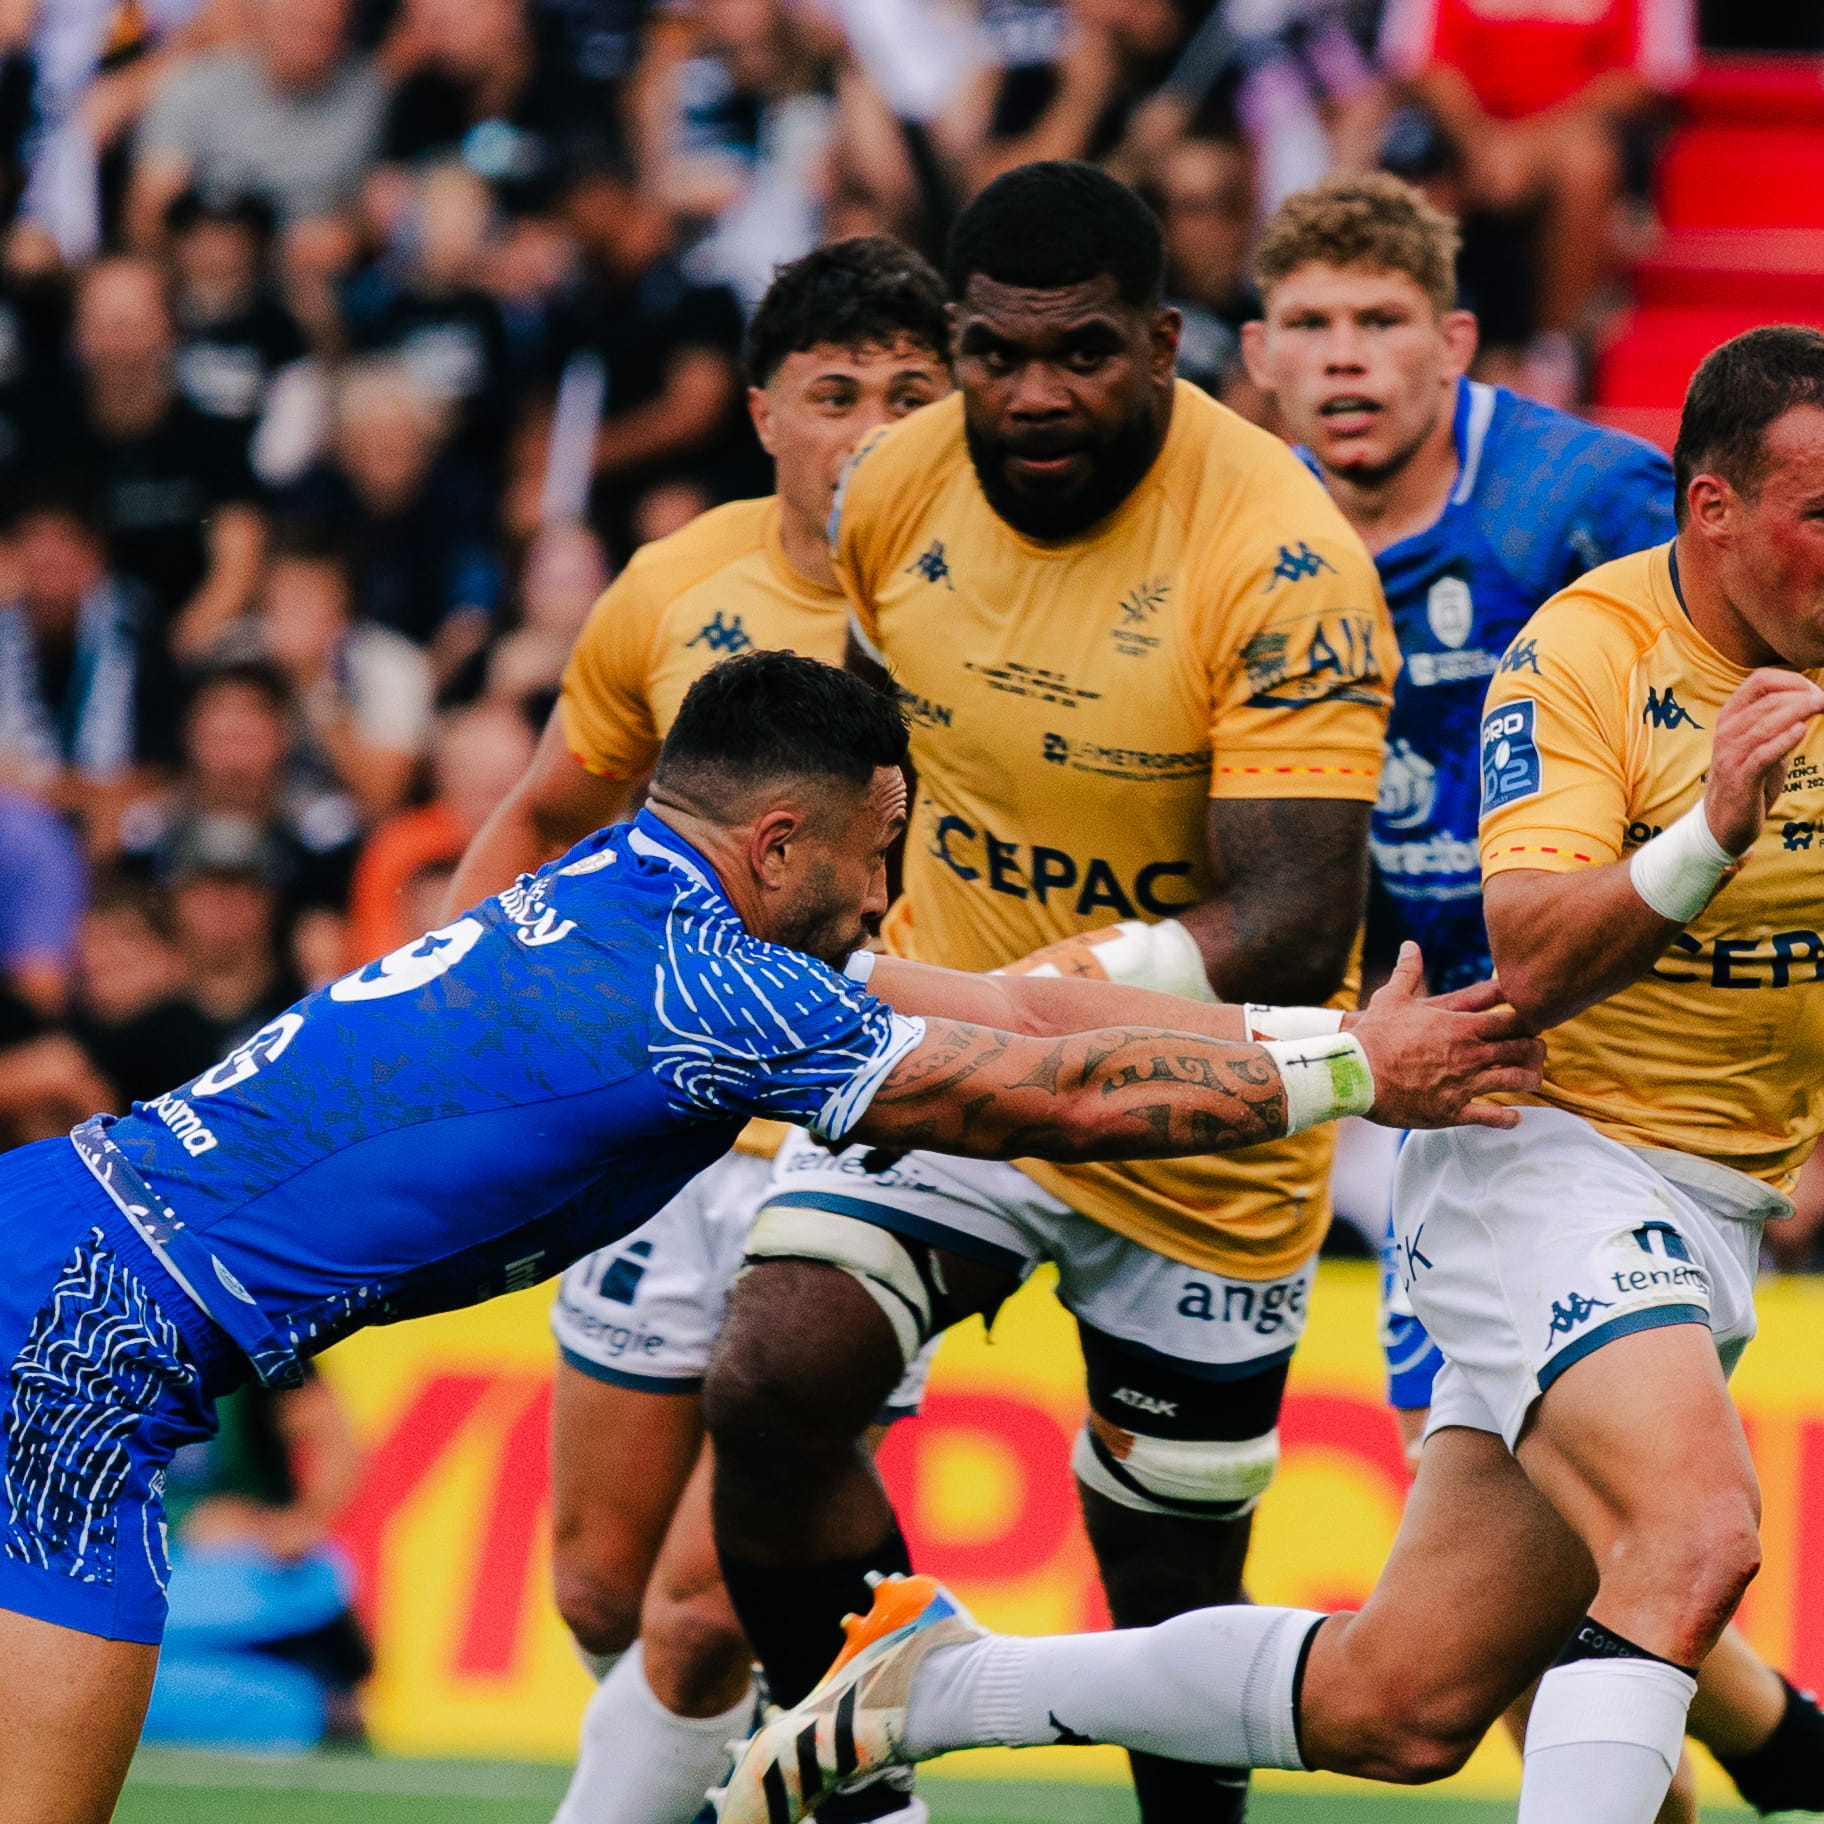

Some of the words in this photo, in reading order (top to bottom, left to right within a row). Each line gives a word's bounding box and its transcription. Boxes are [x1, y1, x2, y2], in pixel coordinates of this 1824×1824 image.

[1483, 712, 1524, 750] PRO
[936, 814, 1194, 920] CEPAC
[1111, 1386, 1180, 1418] ATAK
